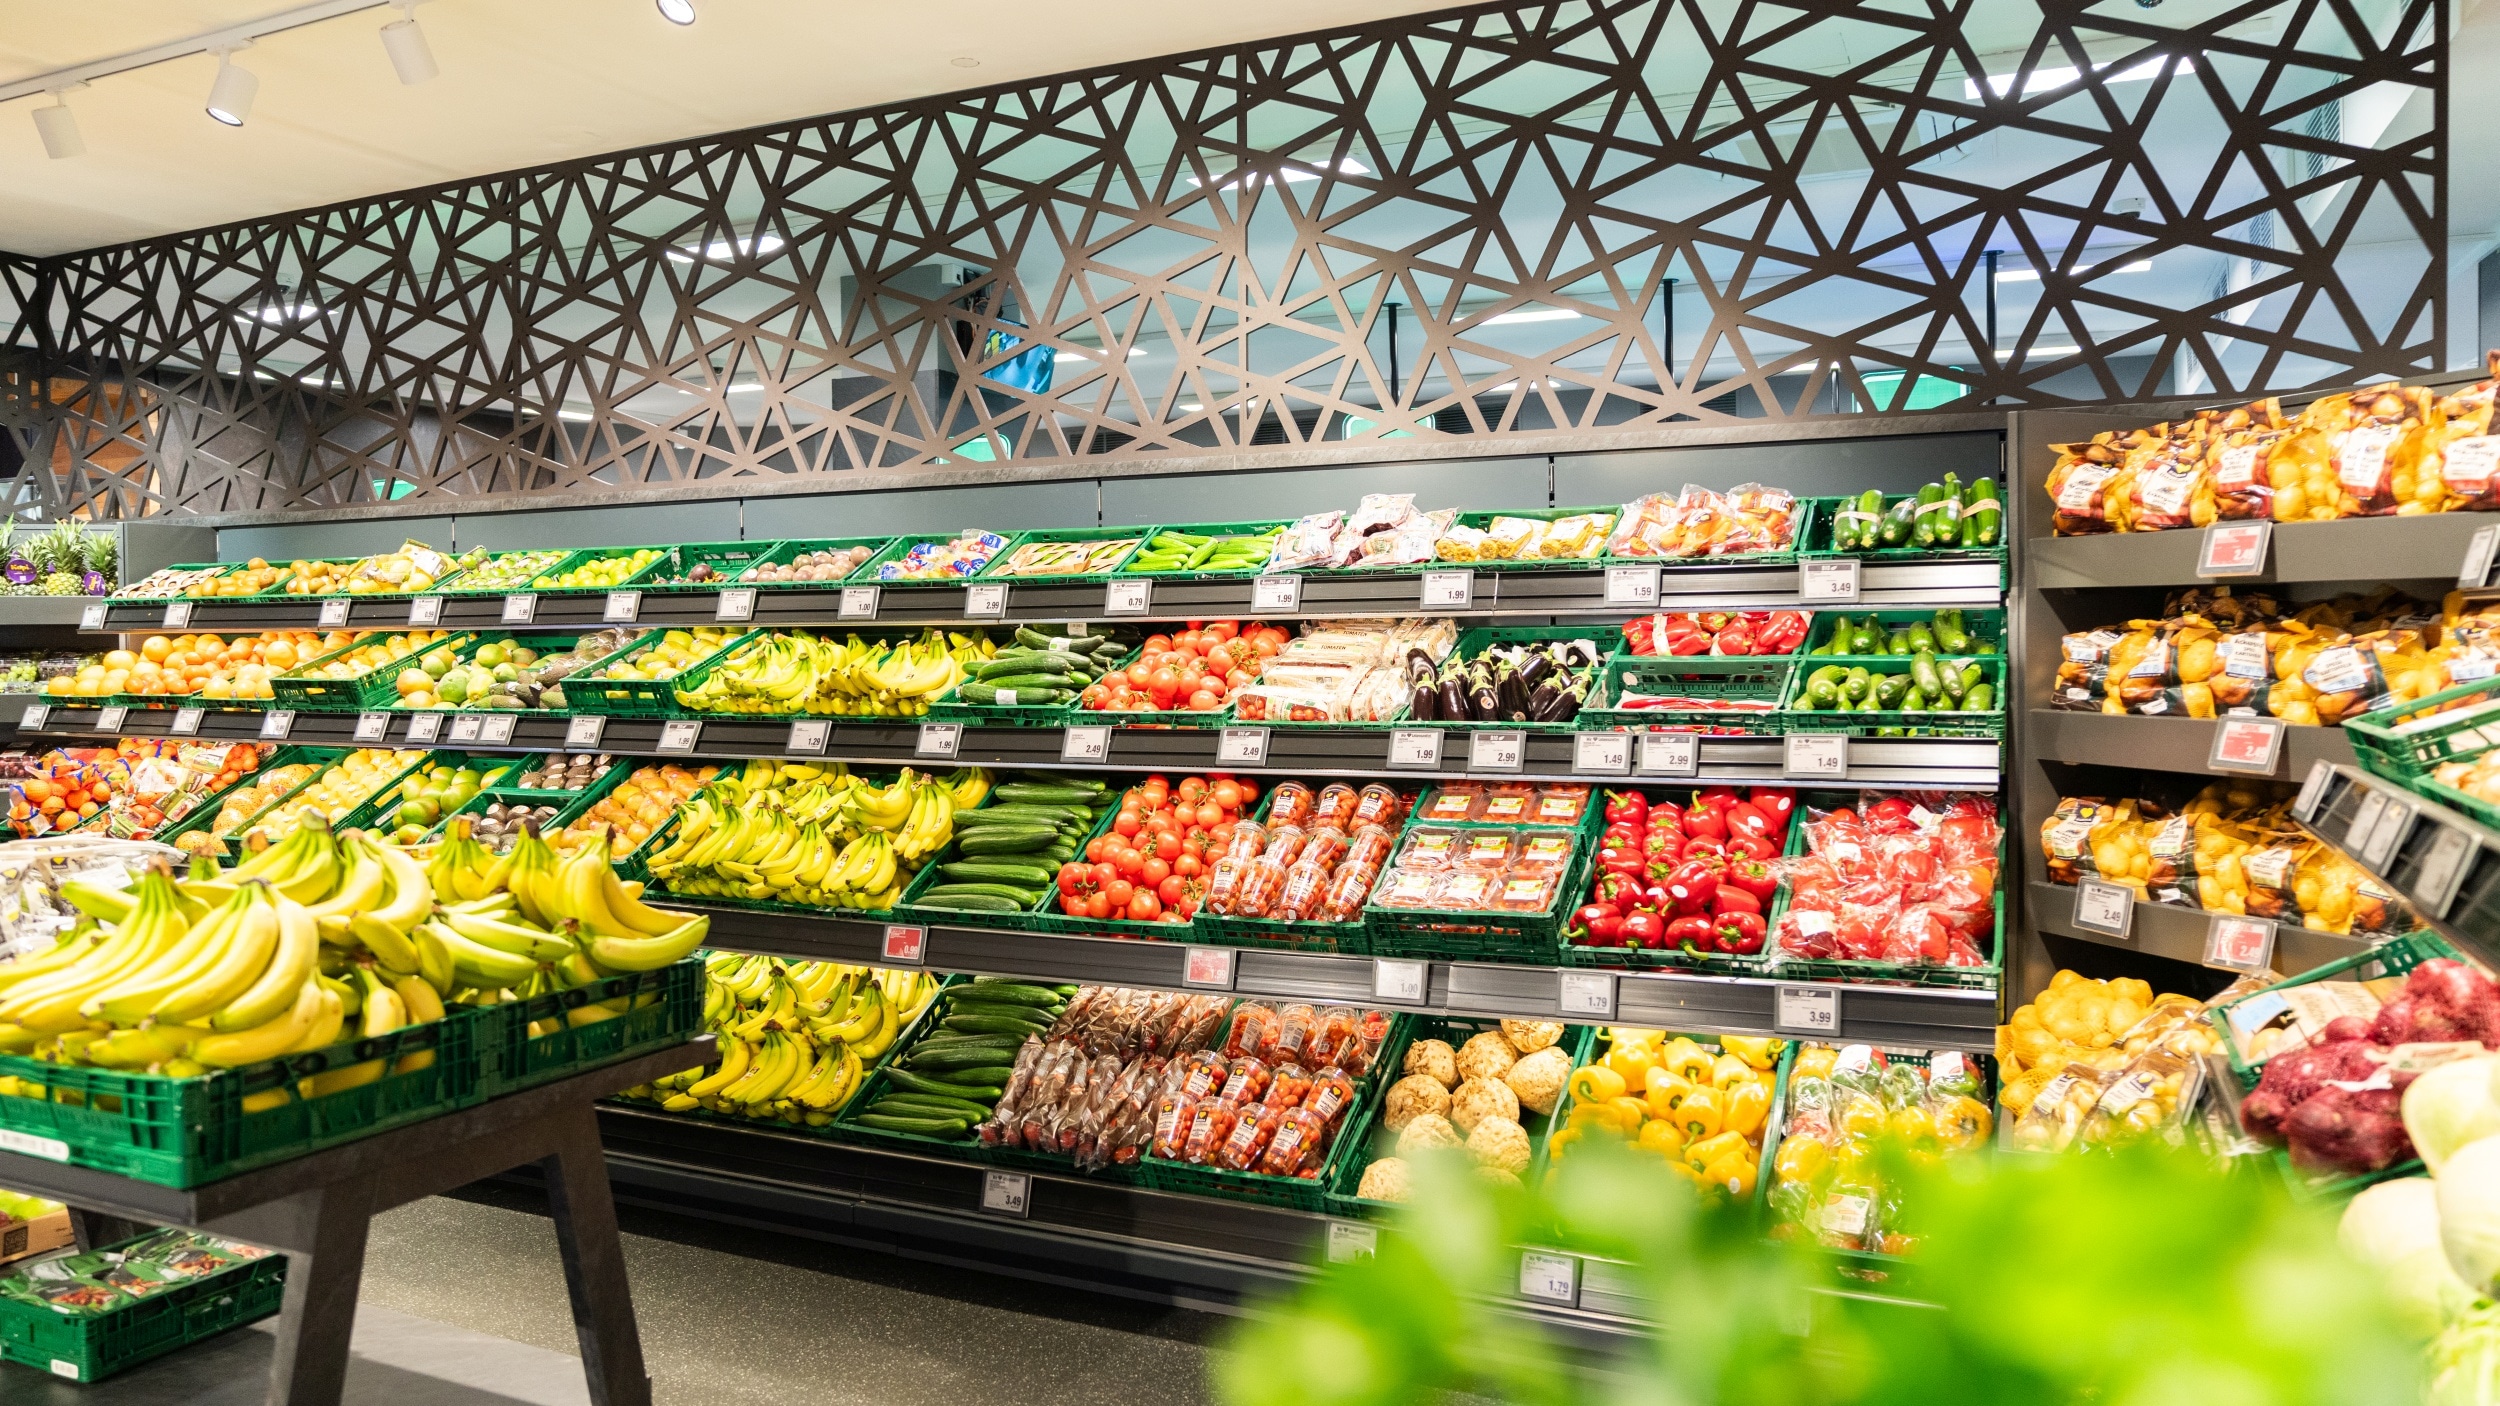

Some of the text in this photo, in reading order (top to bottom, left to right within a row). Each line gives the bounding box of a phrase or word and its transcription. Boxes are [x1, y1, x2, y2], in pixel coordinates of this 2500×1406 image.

[1634, 587, 1651, 595] 1.59
[1832, 583, 1851, 592] 3.49
[1448, 591, 1464, 599] 1.99
[1129, 598, 1142, 606] 0.79
[1086, 745, 1100, 753] 2.49
[1243, 747, 1259, 755] 2.49
[1417, 750, 1433, 758] 1.99
[1498, 753, 1515, 761] 2.99
[1604, 754, 1622, 763] 1.49
[1670, 755, 1688, 764] 2.99
[1818, 757, 1838, 767] 1.49
[2104, 910, 2120, 921] 2.49
[904, 945, 918, 954] 0.99
[1210, 969, 1225, 978] 1.99
[1401, 984, 1418, 993] 1.00
[1588, 997, 1607, 1007] 1.79
[1810, 1011, 1830, 1022] 3.99
[1006, 1195, 1021, 1206] 3.49
[1549, 1280, 1568, 1293] 1.79
